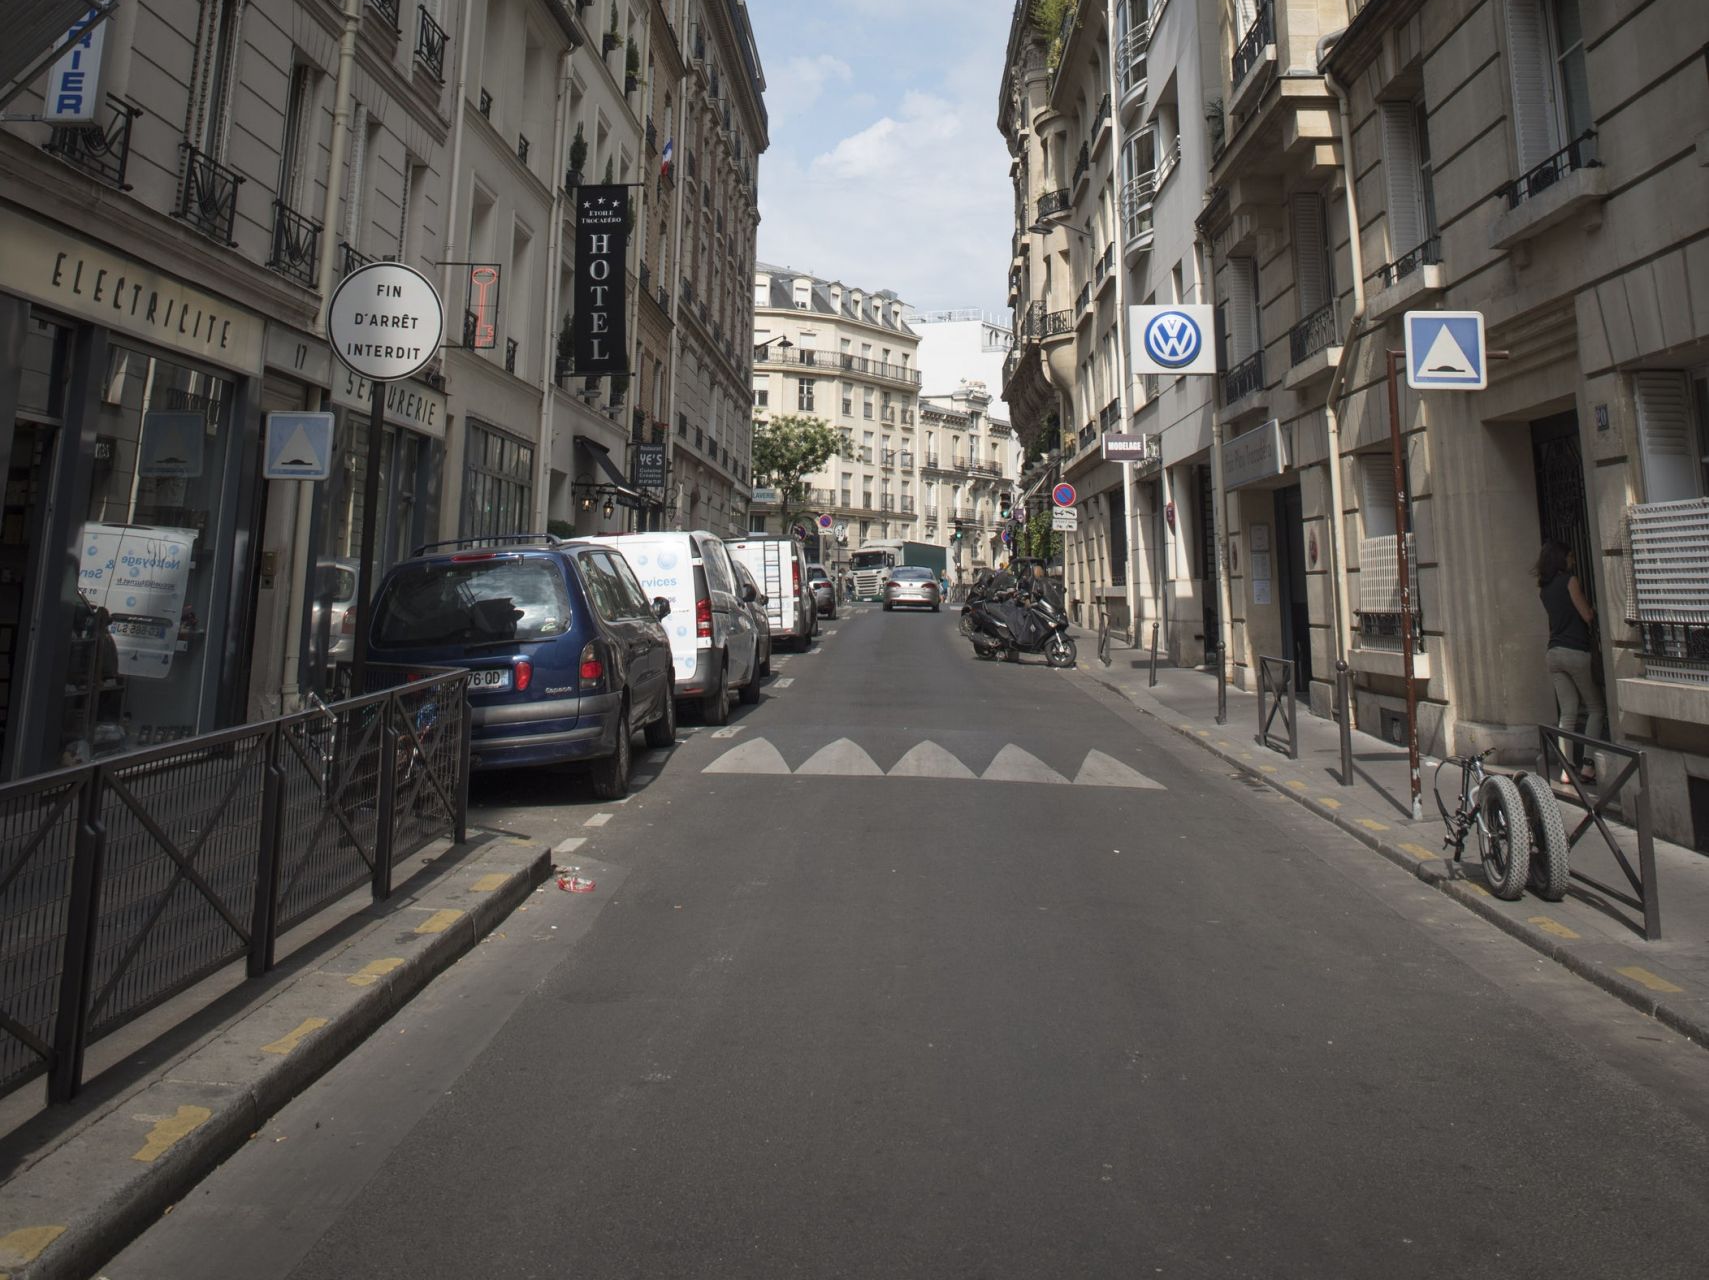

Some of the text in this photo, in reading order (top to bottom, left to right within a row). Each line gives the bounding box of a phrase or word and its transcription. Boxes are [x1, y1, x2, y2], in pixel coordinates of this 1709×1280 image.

[51, 251, 231, 349] ELECTRICITE
[377, 284, 402, 298] FIN
[589, 234, 611, 360] HOTEL
[354, 313, 419, 330] D'ARRÊT
[1149, 314, 1196, 361] VW
[294, 343, 308, 370] 17
[346, 342, 421, 361] INTERDIT
[346, 371, 437, 426] SEURERIE
[1107, 440, 1142, 451] MODELAGE
[640, 453, 663, 465] YE'S
